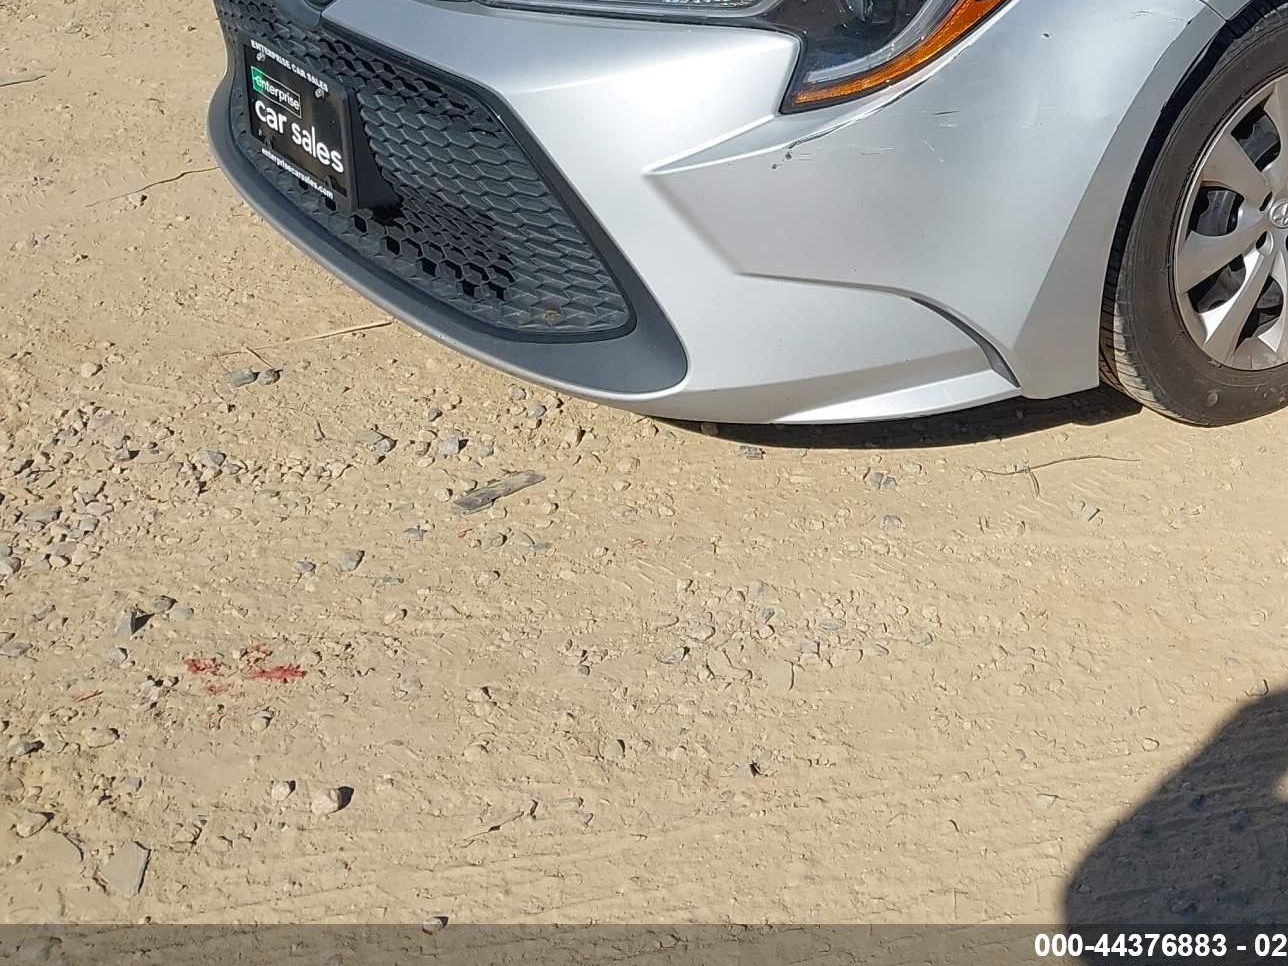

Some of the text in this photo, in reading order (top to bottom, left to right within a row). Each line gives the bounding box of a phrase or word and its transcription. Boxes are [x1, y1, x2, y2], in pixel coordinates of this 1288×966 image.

[251, 39, 329, 93] ENTERPRISE CAR SALES
[254, 75, 301, 111] enterprise
[255, 100, 344, 173] car sales
[261, 147, 334, 200] enterprisecarsales.com
